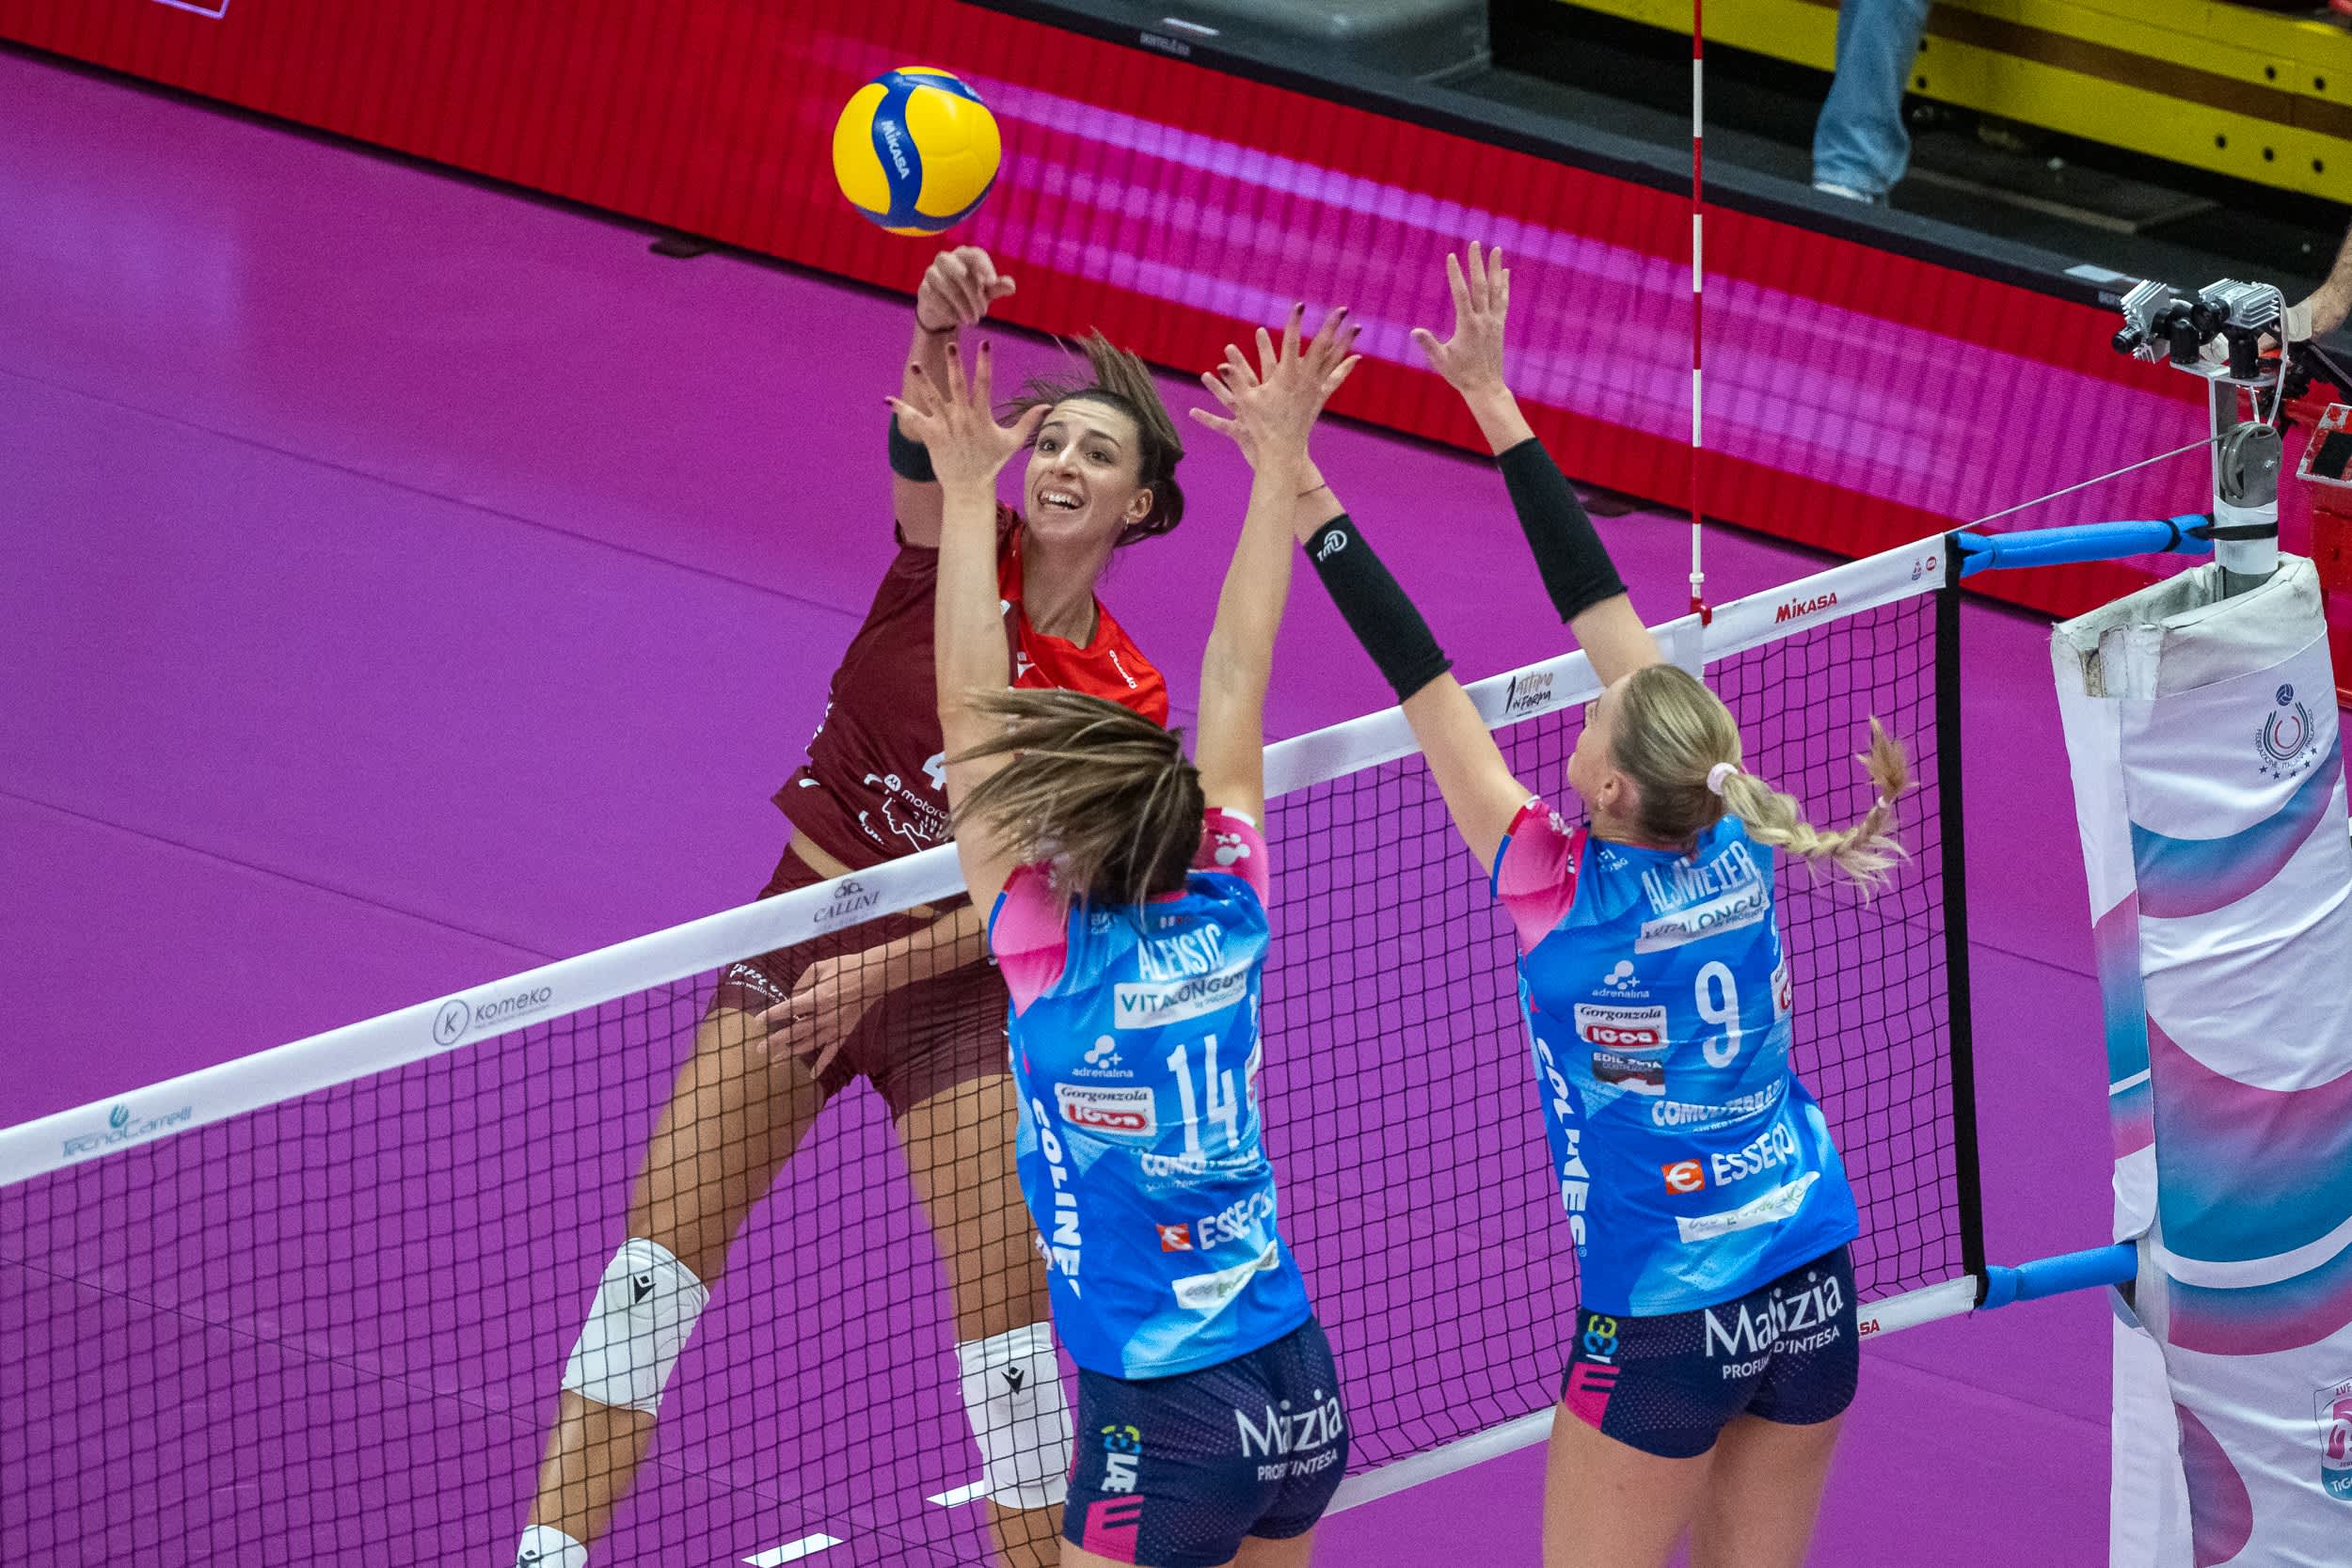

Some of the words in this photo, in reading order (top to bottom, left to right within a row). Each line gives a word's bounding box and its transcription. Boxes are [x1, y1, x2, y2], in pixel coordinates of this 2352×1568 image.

[900, 789, 950, 820] motoro
[1580, 1006, 1662, 1022] Gorgonzola
[1695, 960, 1740, 1069] 9
[1060, 1085, 1149, 1102] Gorgonzola
[1167, 1034, 1241, 1163] 14
[1705, 1272, 1844, 1357] Malizia
[1773, 1325, 1841, 1354] D'INTESA
